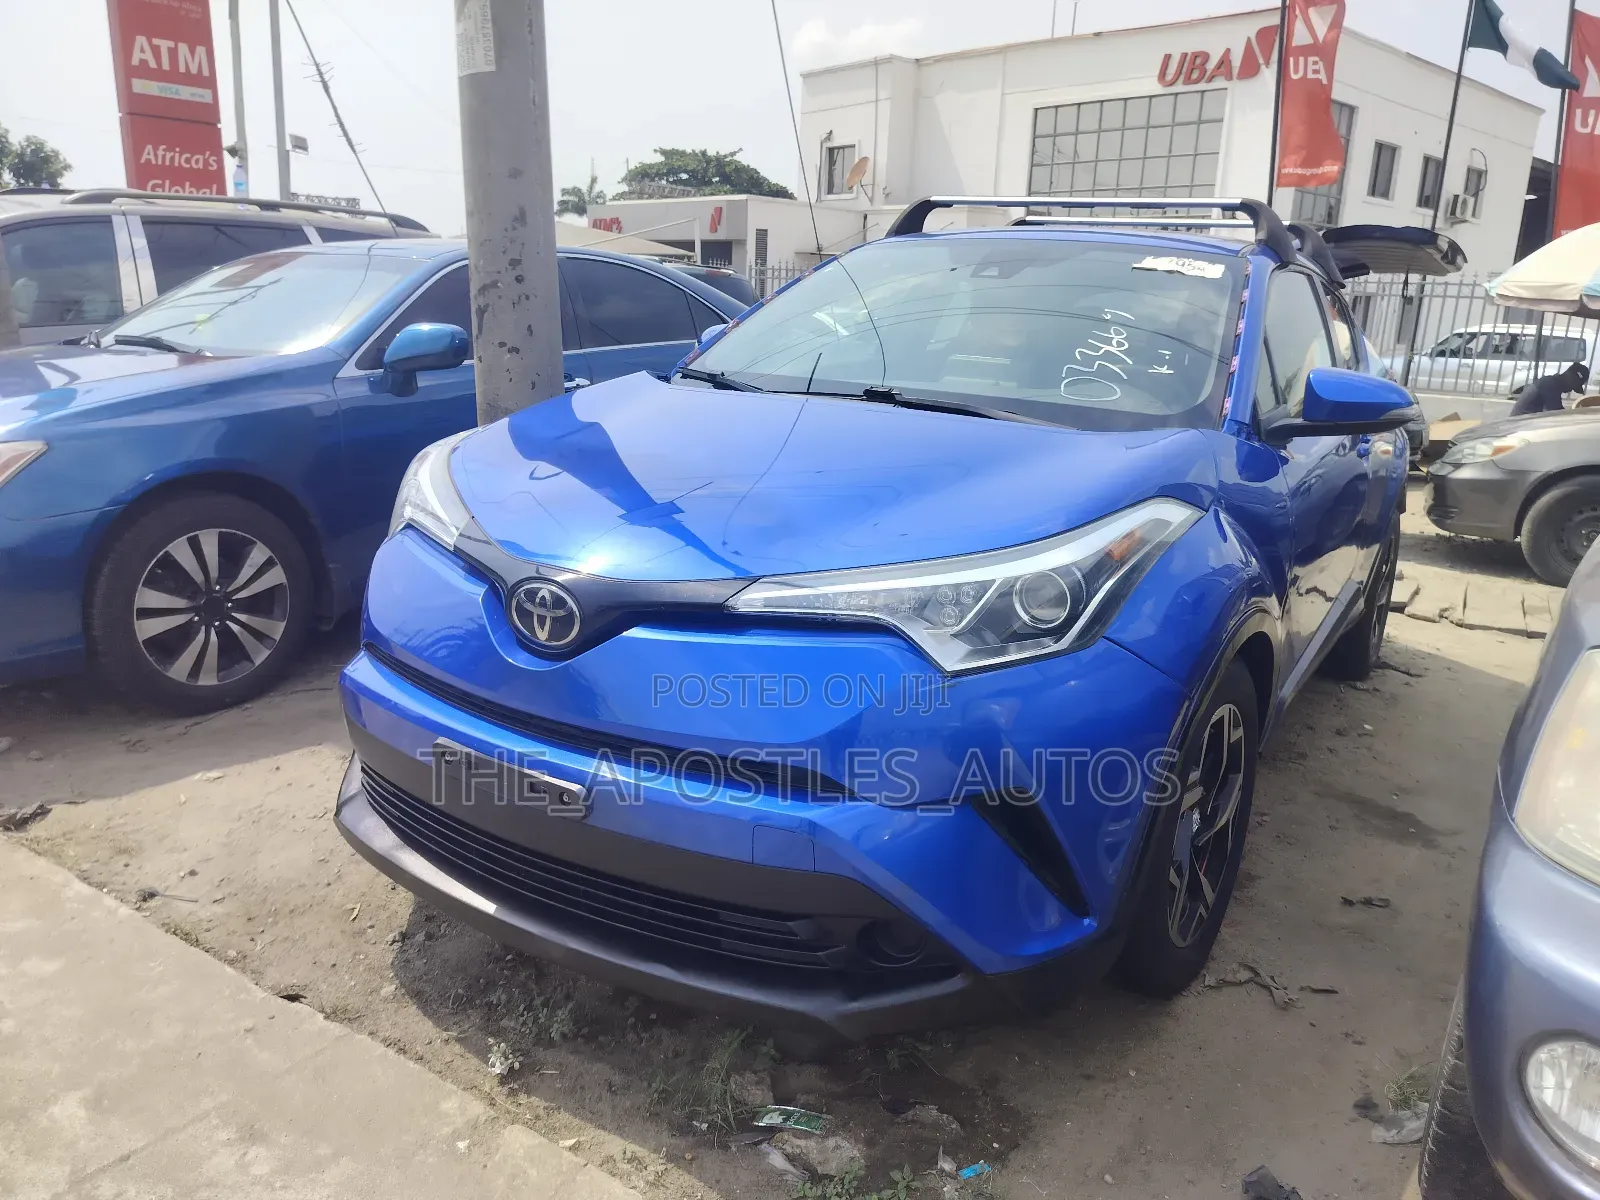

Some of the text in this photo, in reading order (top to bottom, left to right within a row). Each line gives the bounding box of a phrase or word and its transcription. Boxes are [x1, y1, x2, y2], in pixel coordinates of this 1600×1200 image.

[132, 35, 210, 77] ATM
[1157, 48, 1233, 87] UBA
[1289, 56, 1328, 85] UBA
[157, 84, 181, 97] VISA
[140, 145, 218, 170] Africa's
